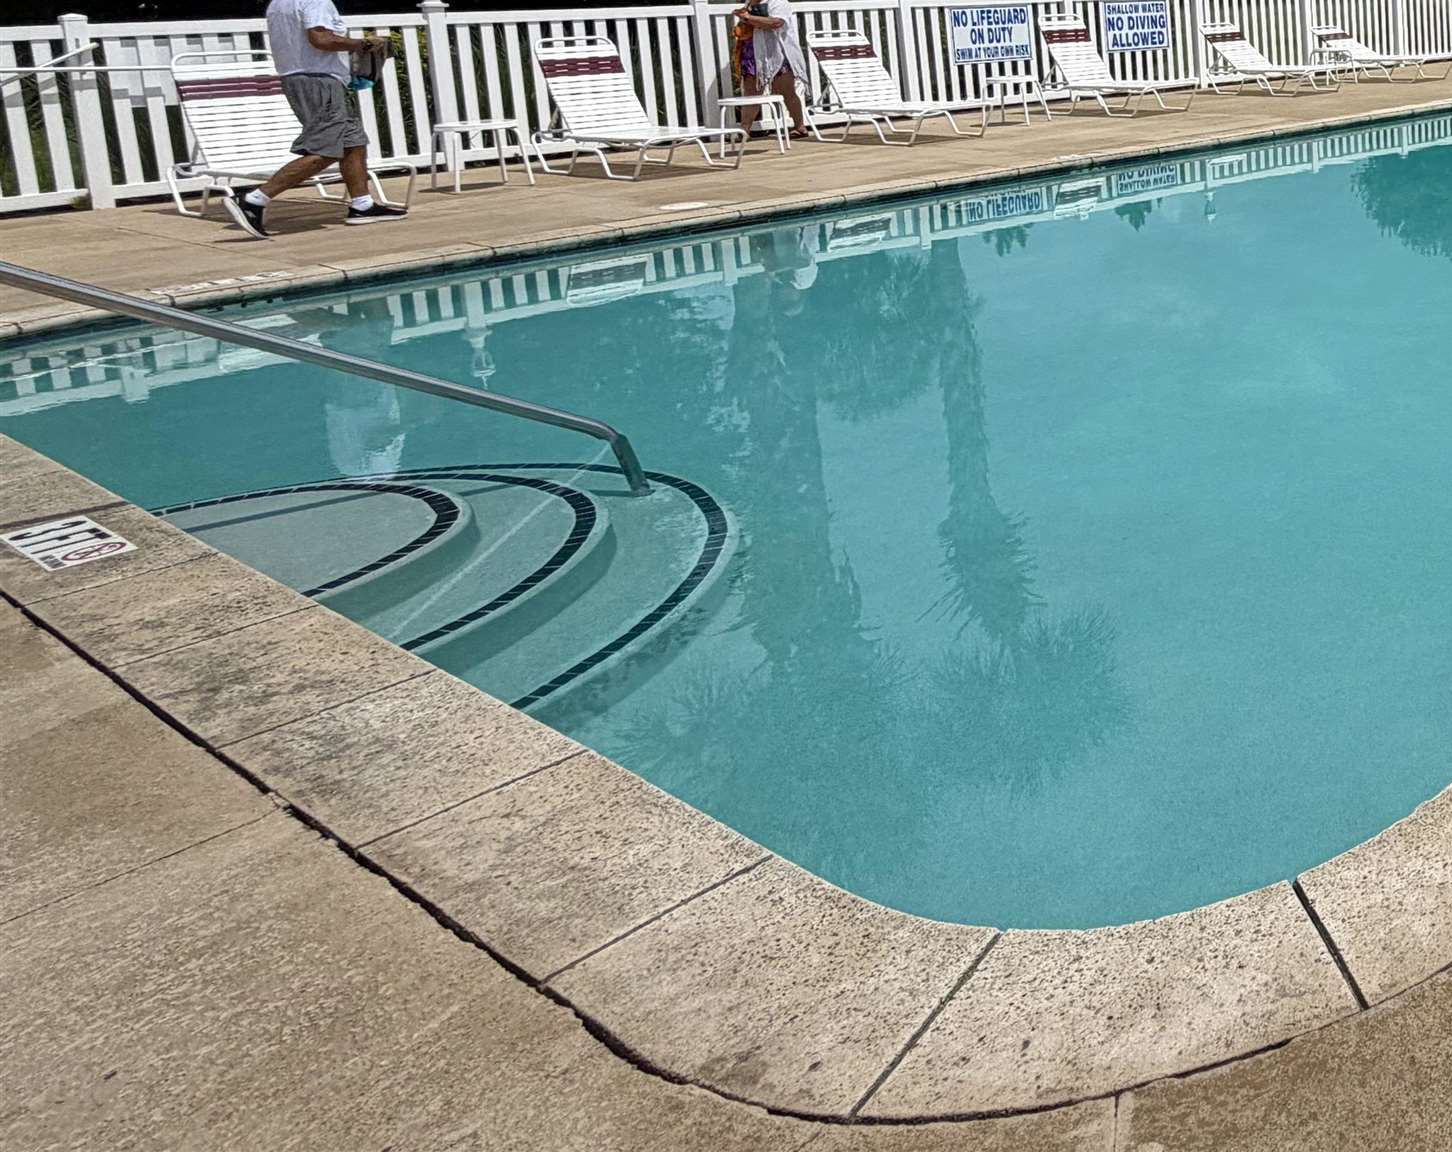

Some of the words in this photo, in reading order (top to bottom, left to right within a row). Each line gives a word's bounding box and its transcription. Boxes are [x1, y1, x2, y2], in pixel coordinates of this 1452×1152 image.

[1107, 3, 1140, 15] SHALLOW
[1141, 2, 1165, 14] WATER
[953, 10, 968, 28] NO
[970, 8, 1026, 27] LIFEGUARD
[1106, 16, 1124, 32] NO
[1127, 14, 1166, 30] DIVING
[970, 28, 985, 45] ON
[987, 26, 1013, 44] DUTY
[1112, 30, 1165, 48] ALLOWED
[956, 48, 973, 60] SWIM
[974, 47, 982, 59] AT
[983, 46, 999, 58] YOUR
[1000, 45, 1014, 57] OWN
[1015, 44, 1029, 56] RISK
[8, 520, 87, 541] 3
[16, 527, 113, 554] FT
